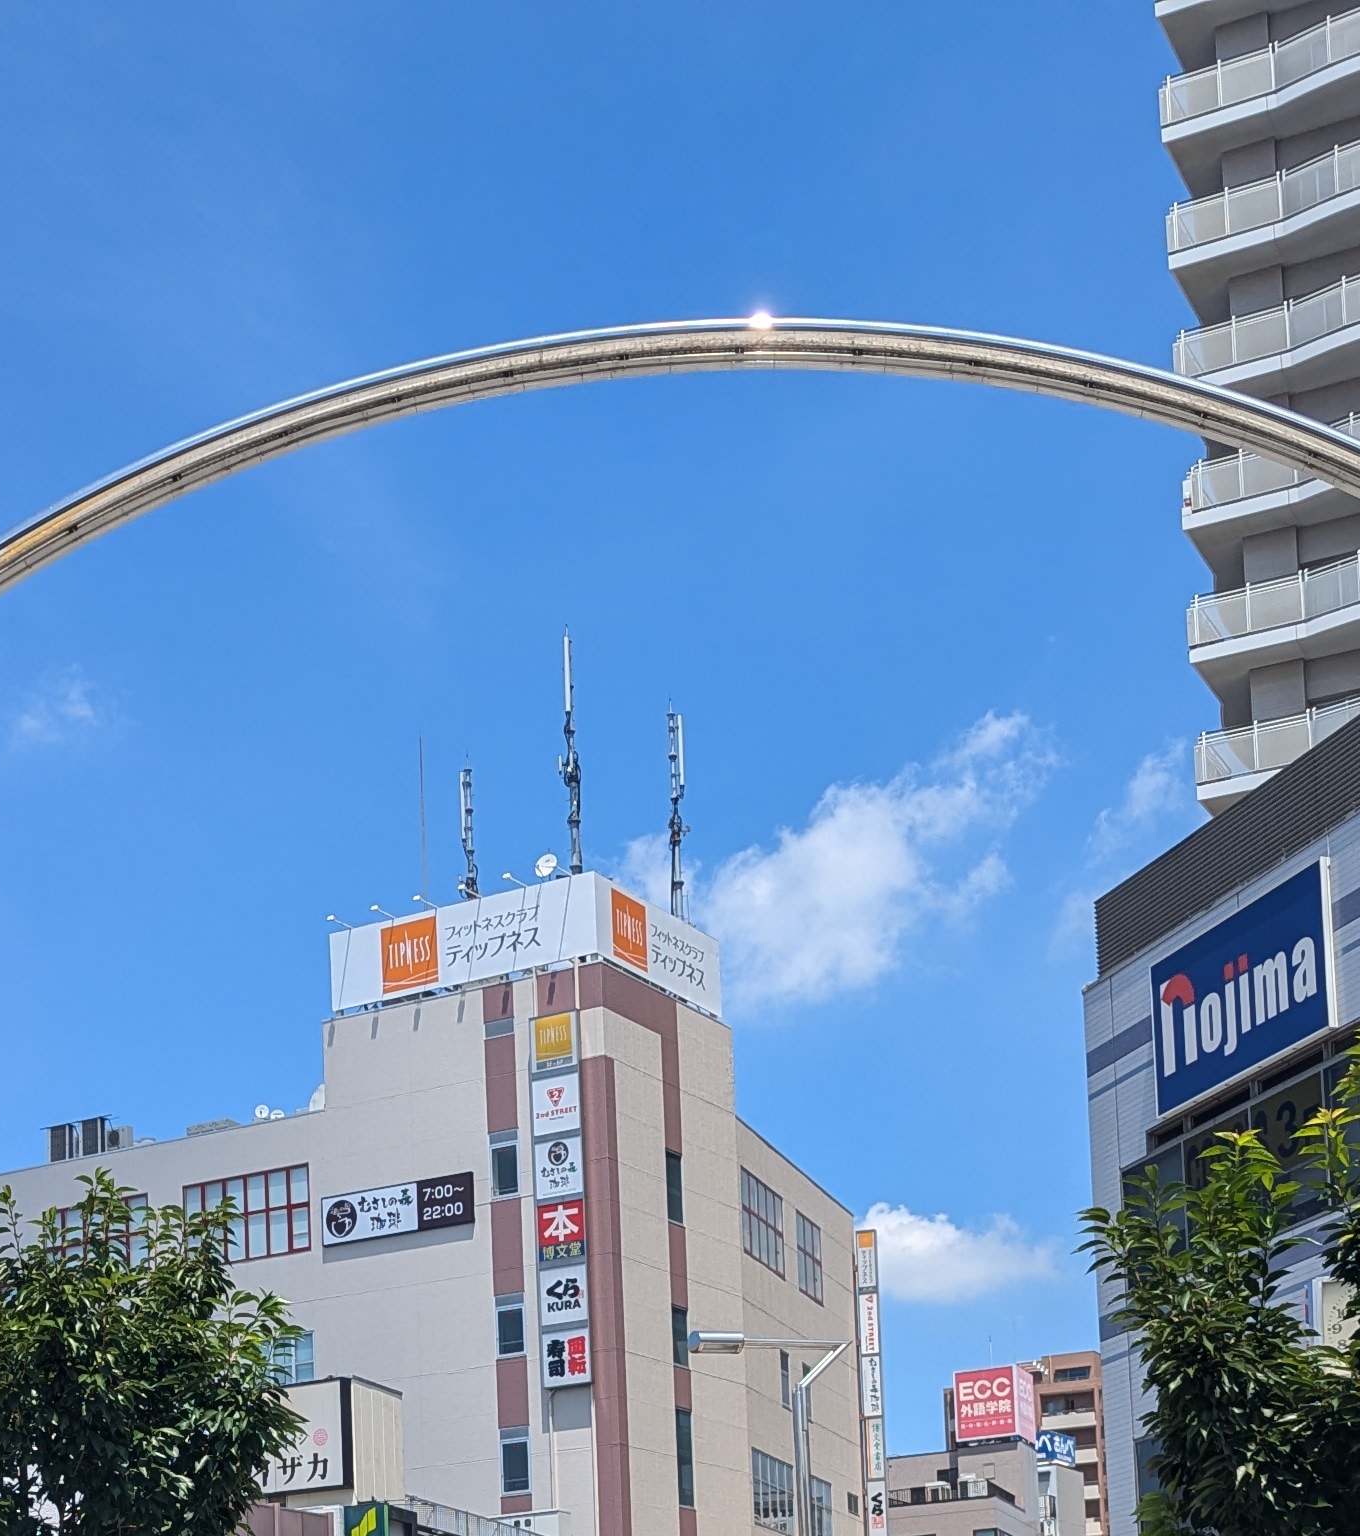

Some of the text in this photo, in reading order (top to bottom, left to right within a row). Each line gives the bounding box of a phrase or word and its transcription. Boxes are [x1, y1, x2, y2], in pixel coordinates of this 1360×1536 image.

[444, 904, 540, 942] フィットネスクラブ
[616, 904, 643, 951] TIPNESS
[389, 931, 431, 974] TIPNESS
[445, 926, 542, 968] ティップネス
[650, 923, 705, 963] フィットネスクラブ
[651, 943, 707, 992] ティップネス
[539, 1023, 568, 1047] TIPNESS
[550, 1105, 578, 1117] STREET
[369, 1207, 402, 1232] 珈琲
[422, 1201, 464, 1221] 22:00
[542, 1204, 580, 1242] 本
[542, 1241, 582, 1261] 博文堂
[546, 1278, 581, 1301] くら
[547, 1298, 582, 1314] KURA
[1331, 1323, 1343, 1335] 9
[958, 1376, 1011, 1401] ECC
[960, 1398, 1012, 1419] 外語学院
[870, 1491, 884, 1517] くら
